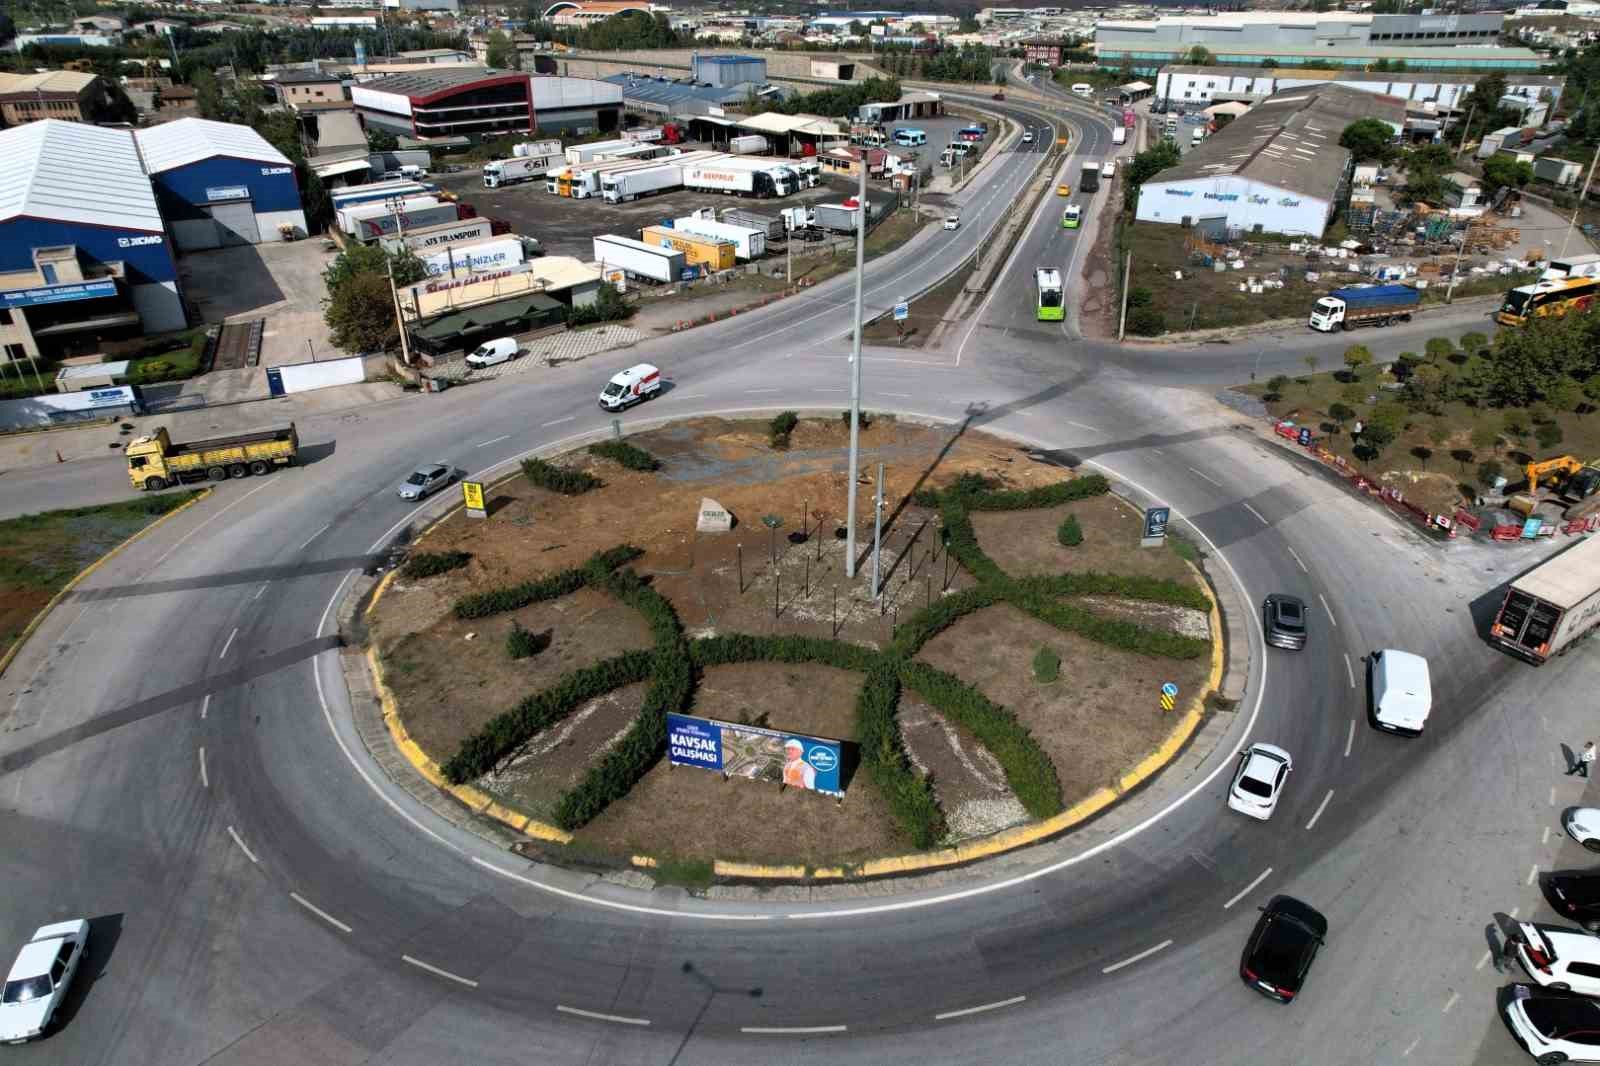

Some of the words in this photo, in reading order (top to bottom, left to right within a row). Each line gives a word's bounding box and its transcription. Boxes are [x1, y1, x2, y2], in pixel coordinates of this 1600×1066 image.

[130, 235, 163, 246] XCMG
[424, 235, 438, 247] ATS
[439, 228, 481, 243] TRANSPORT
[670, 733, 717, 753] KAVŞAK
[671, 746, 718, 763] ÇALIŞMASI
